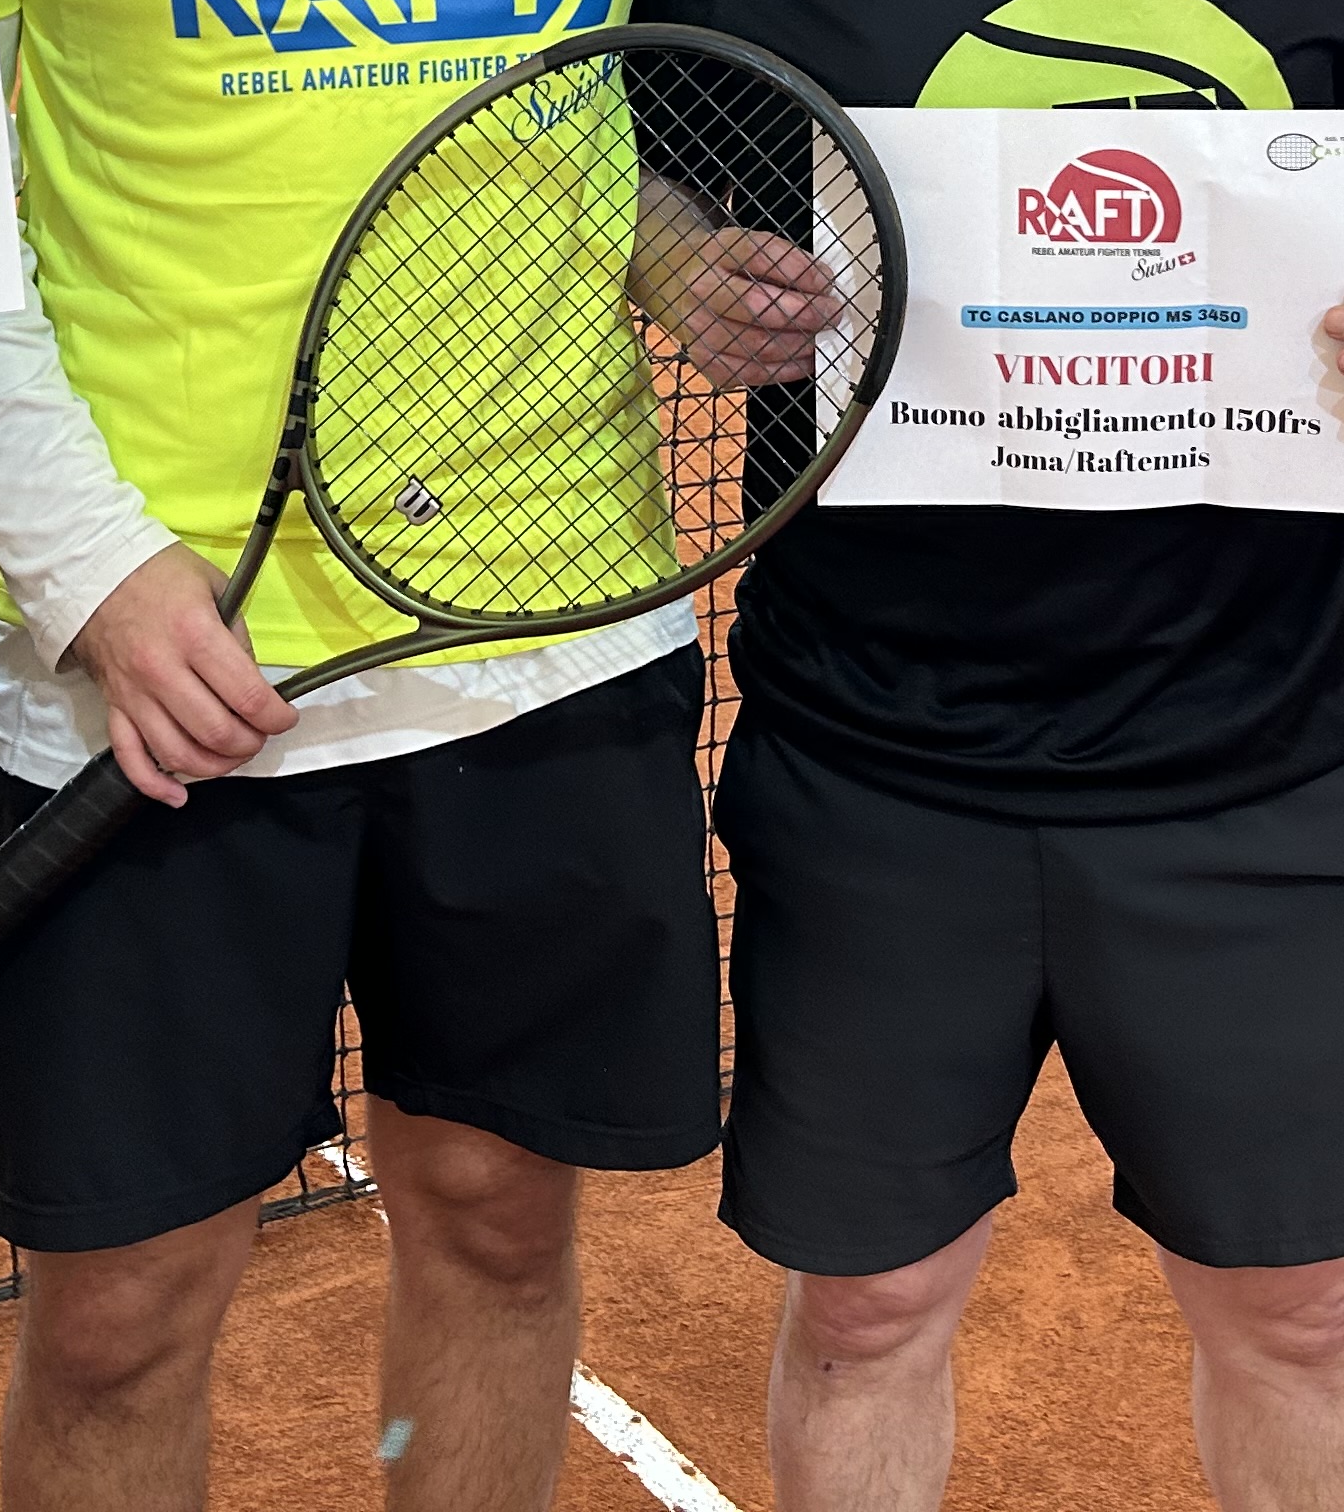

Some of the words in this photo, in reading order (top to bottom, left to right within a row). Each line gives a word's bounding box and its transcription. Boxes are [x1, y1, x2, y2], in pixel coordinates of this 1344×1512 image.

[221, 69, 293, 97] REBEL
[303, 62, 410, 92] AMATEUR
[419, 54, 507, 85] FIGHTER
[1018, 188, 1151, 237] RAFT
[1031, 247, 1056, 256] REBEL
[1058, 247, 1095, 256] AMATEUR
[1097, 248, 1130, 257] FIGHTER
[1132, 248, 1161, 256] TENNIS
[1131, 257, 1176, 281] Swiss
[967, 310, 991, 322] TC
[997, 310, 1084, 324] CASLANO
[1091, 311, 1160, 324] DOPPIO
[1166, 310, 1192, 323] MS
[1197, 308, 1241, 323] 3450
[993, 353, 1213, 386] VINCITORI
[889, 400, 985, 427] Buono
[998, 405, 1216, 440] abbigliamento
[1222, 407, 1322, 436] 150frs
[990, 445, 1210, 474] Joma/Raftennis
